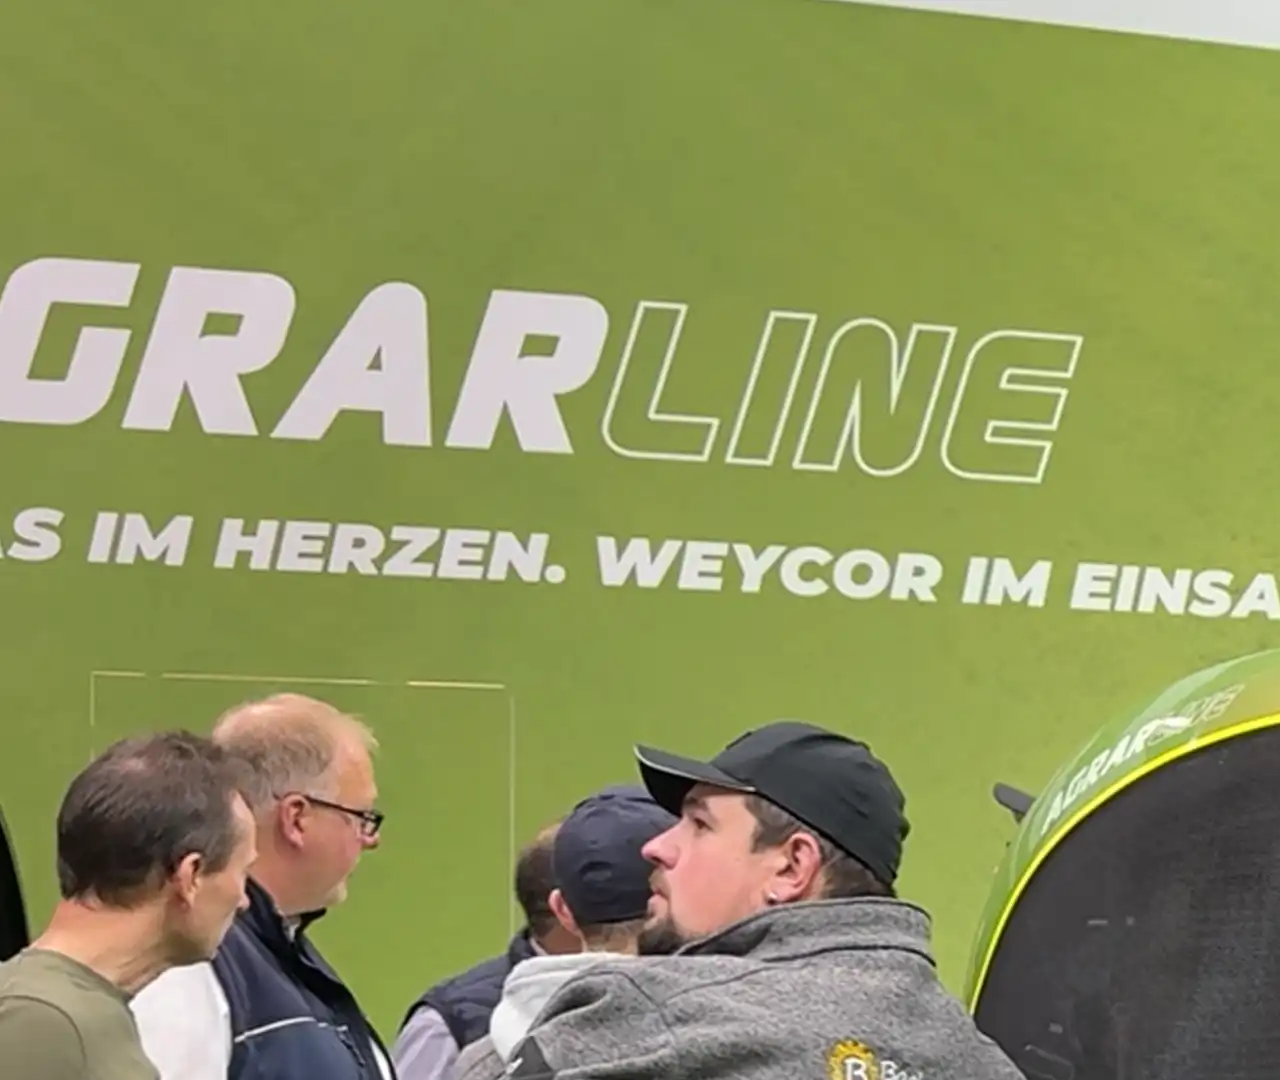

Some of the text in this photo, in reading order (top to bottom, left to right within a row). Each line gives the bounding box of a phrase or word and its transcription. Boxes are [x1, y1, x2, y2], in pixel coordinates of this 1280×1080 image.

[0, 506, 65, 562] S
[87, 511, 194, 567] IM
[213, 517, 566, 585] HERZEN.
[597, 535, 944, 603] WEYCOR
[962, 557, 1053, 608] IM
